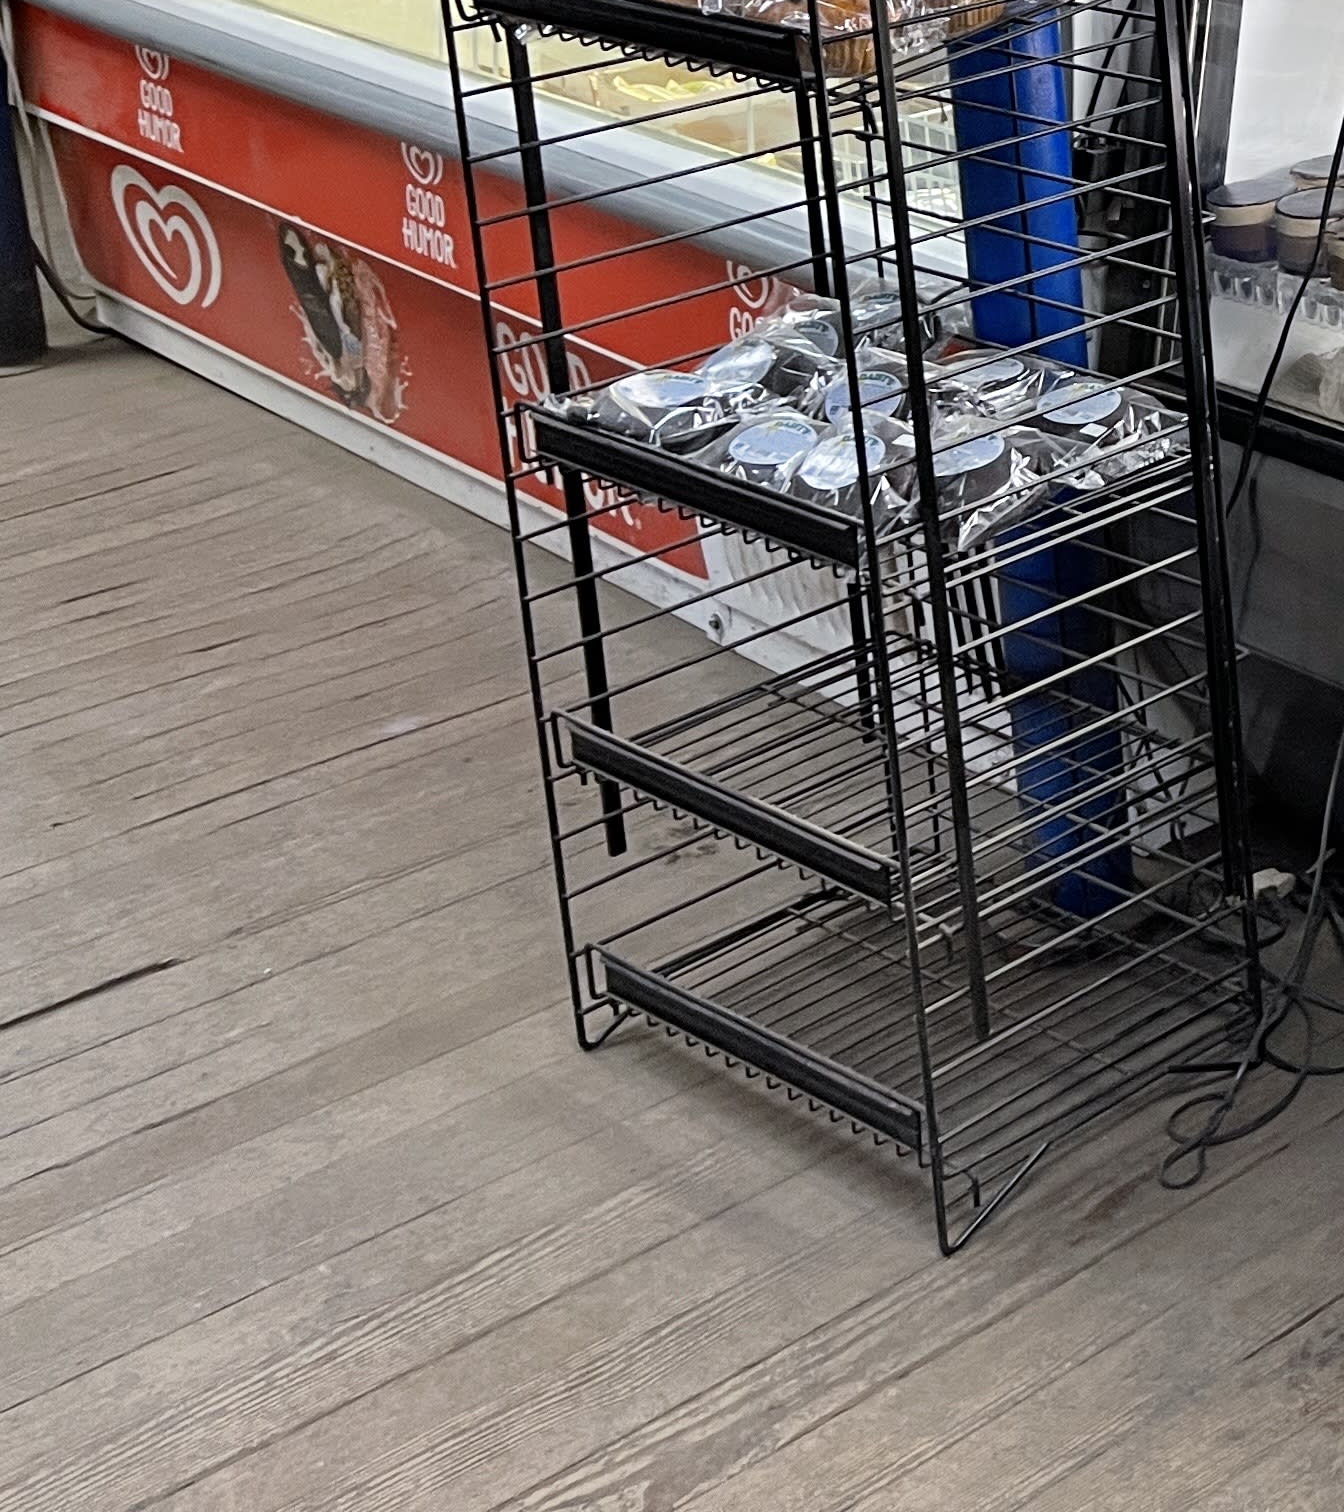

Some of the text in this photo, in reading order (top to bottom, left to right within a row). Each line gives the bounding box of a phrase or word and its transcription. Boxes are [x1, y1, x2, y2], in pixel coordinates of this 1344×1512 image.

[139, 79, 174, 117] GOOD
[137, 108, 184, 153] HUMOR
[406, 183, 445, 228] GOOD
[402, 217, 457, 268] HUMOR
[497, 321, 592, 402] GOD
